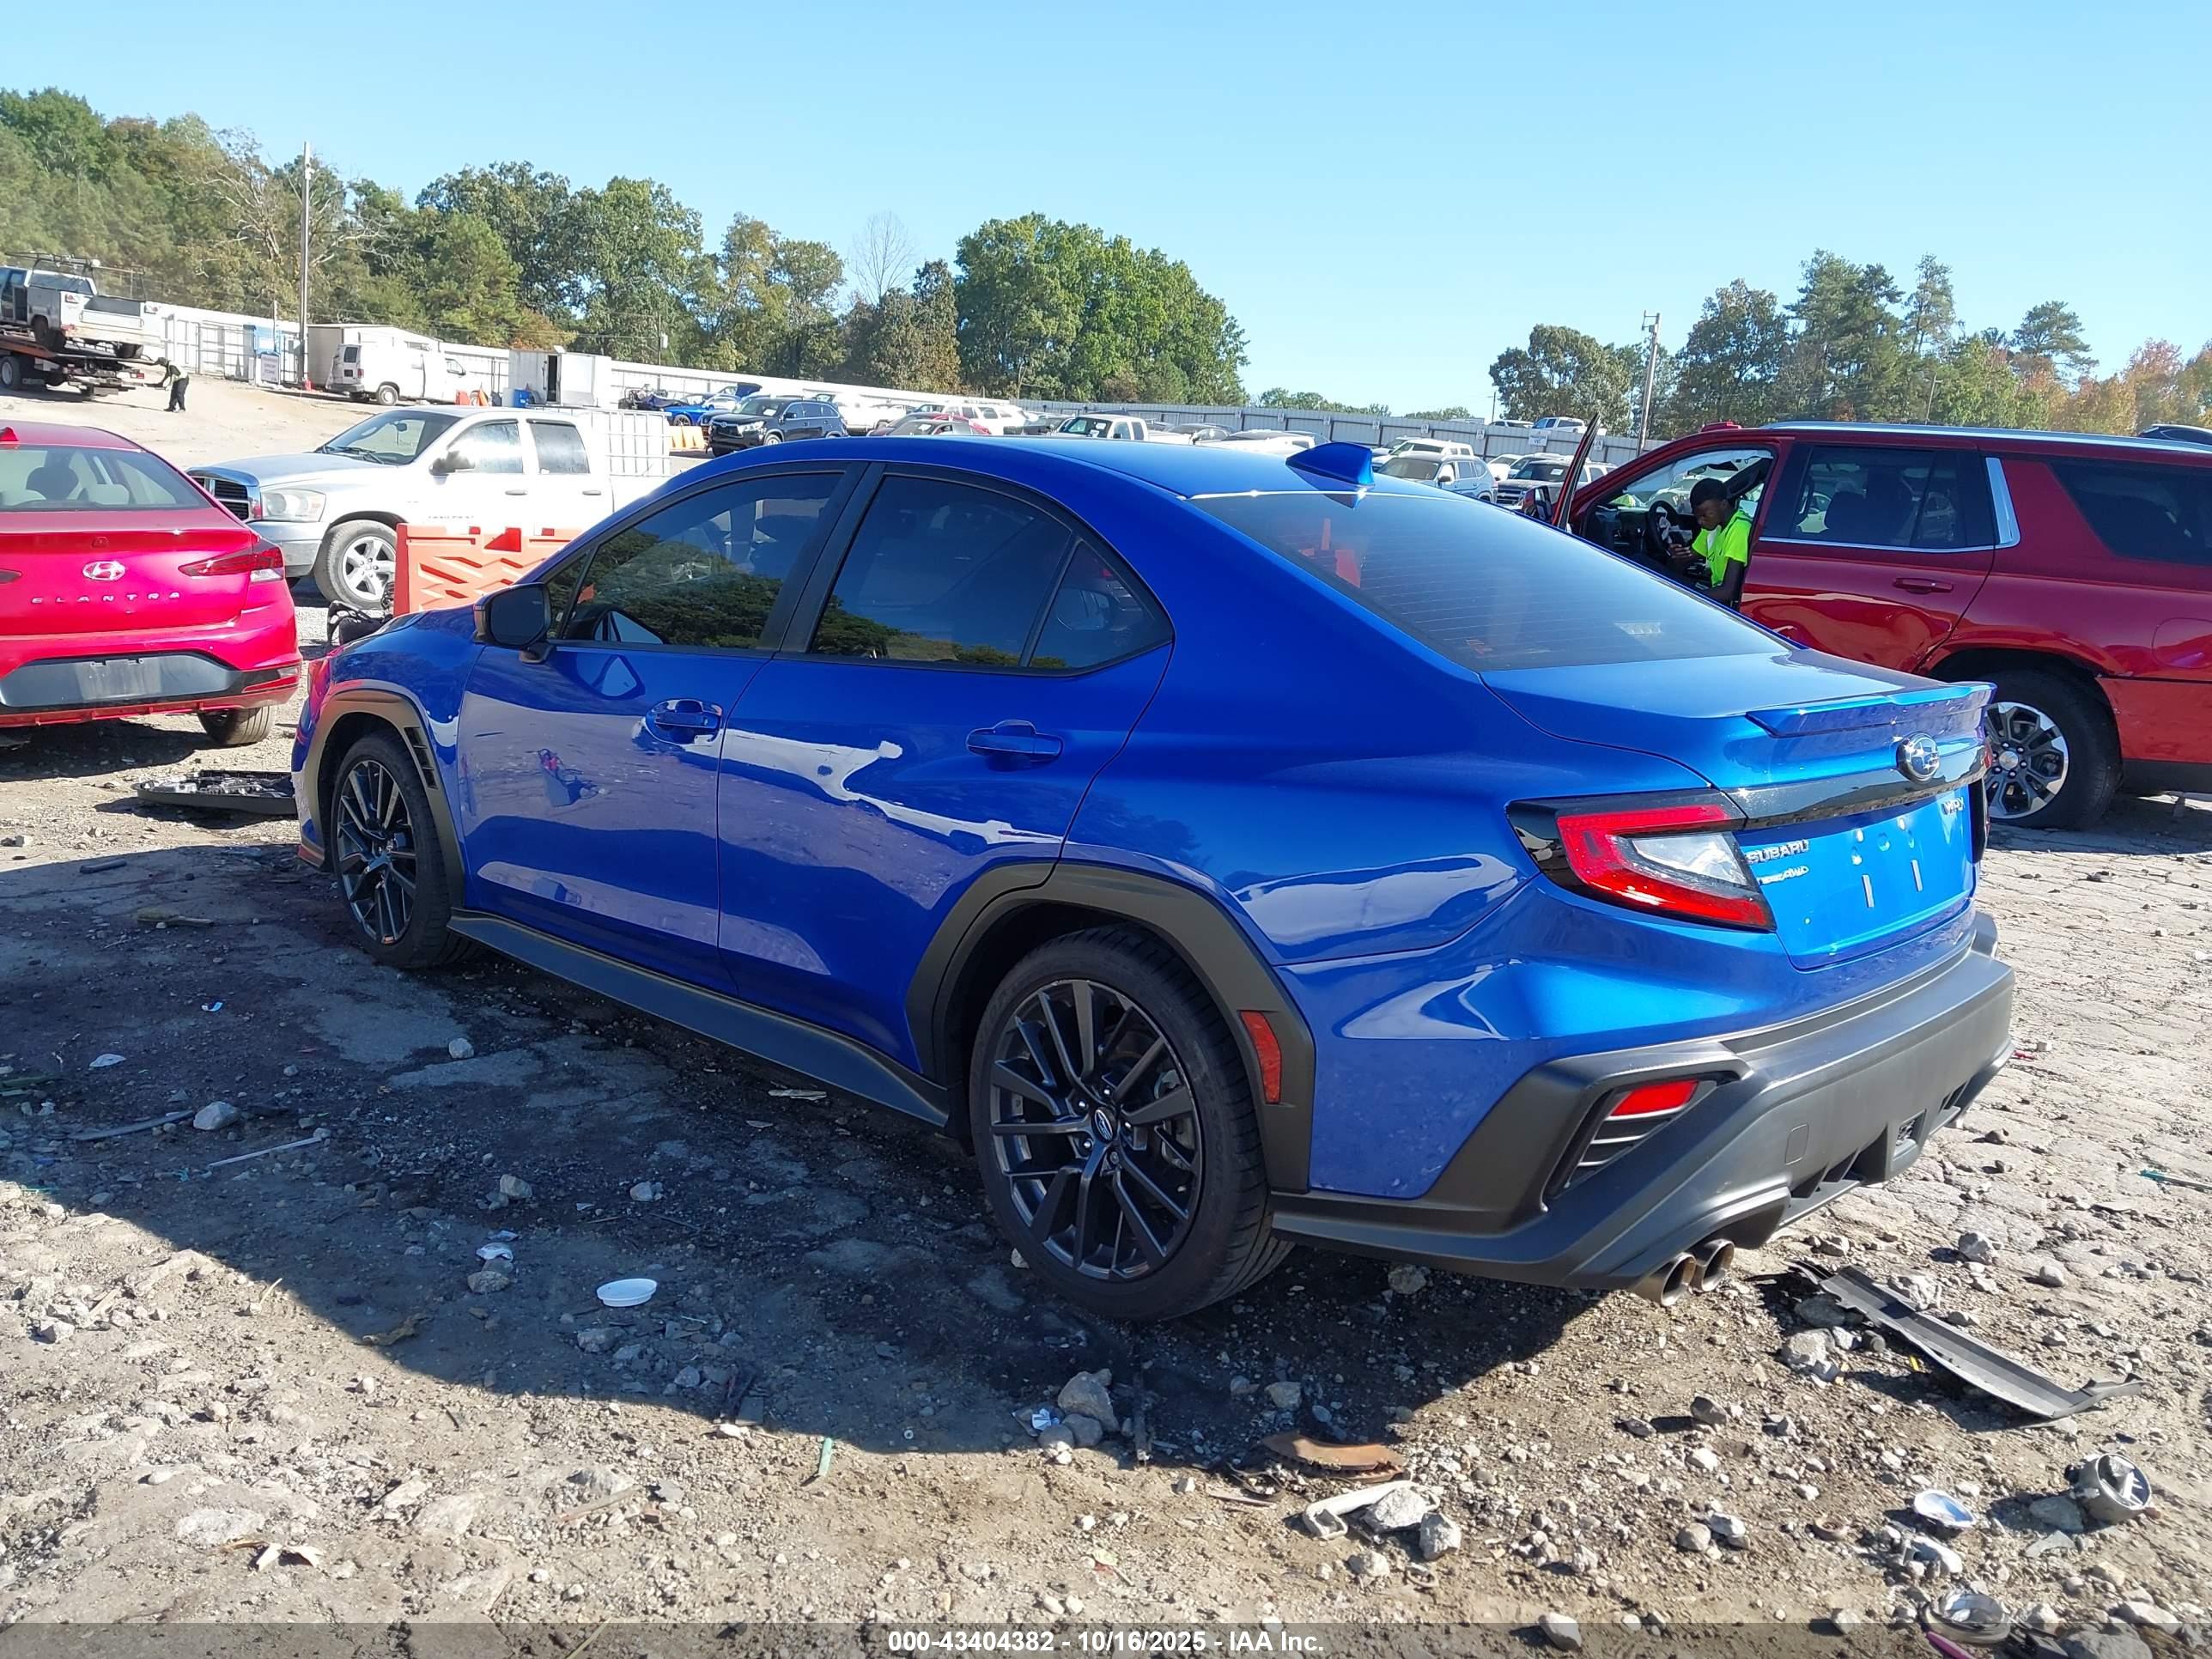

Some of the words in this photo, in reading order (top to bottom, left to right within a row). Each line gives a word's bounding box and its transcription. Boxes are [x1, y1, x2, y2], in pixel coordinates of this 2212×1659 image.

[31, 591, 180, 603] ELANTRA
[1941, 797, 1965, 817] WRX
[1744, 838, 1810, 865] SUBARU
